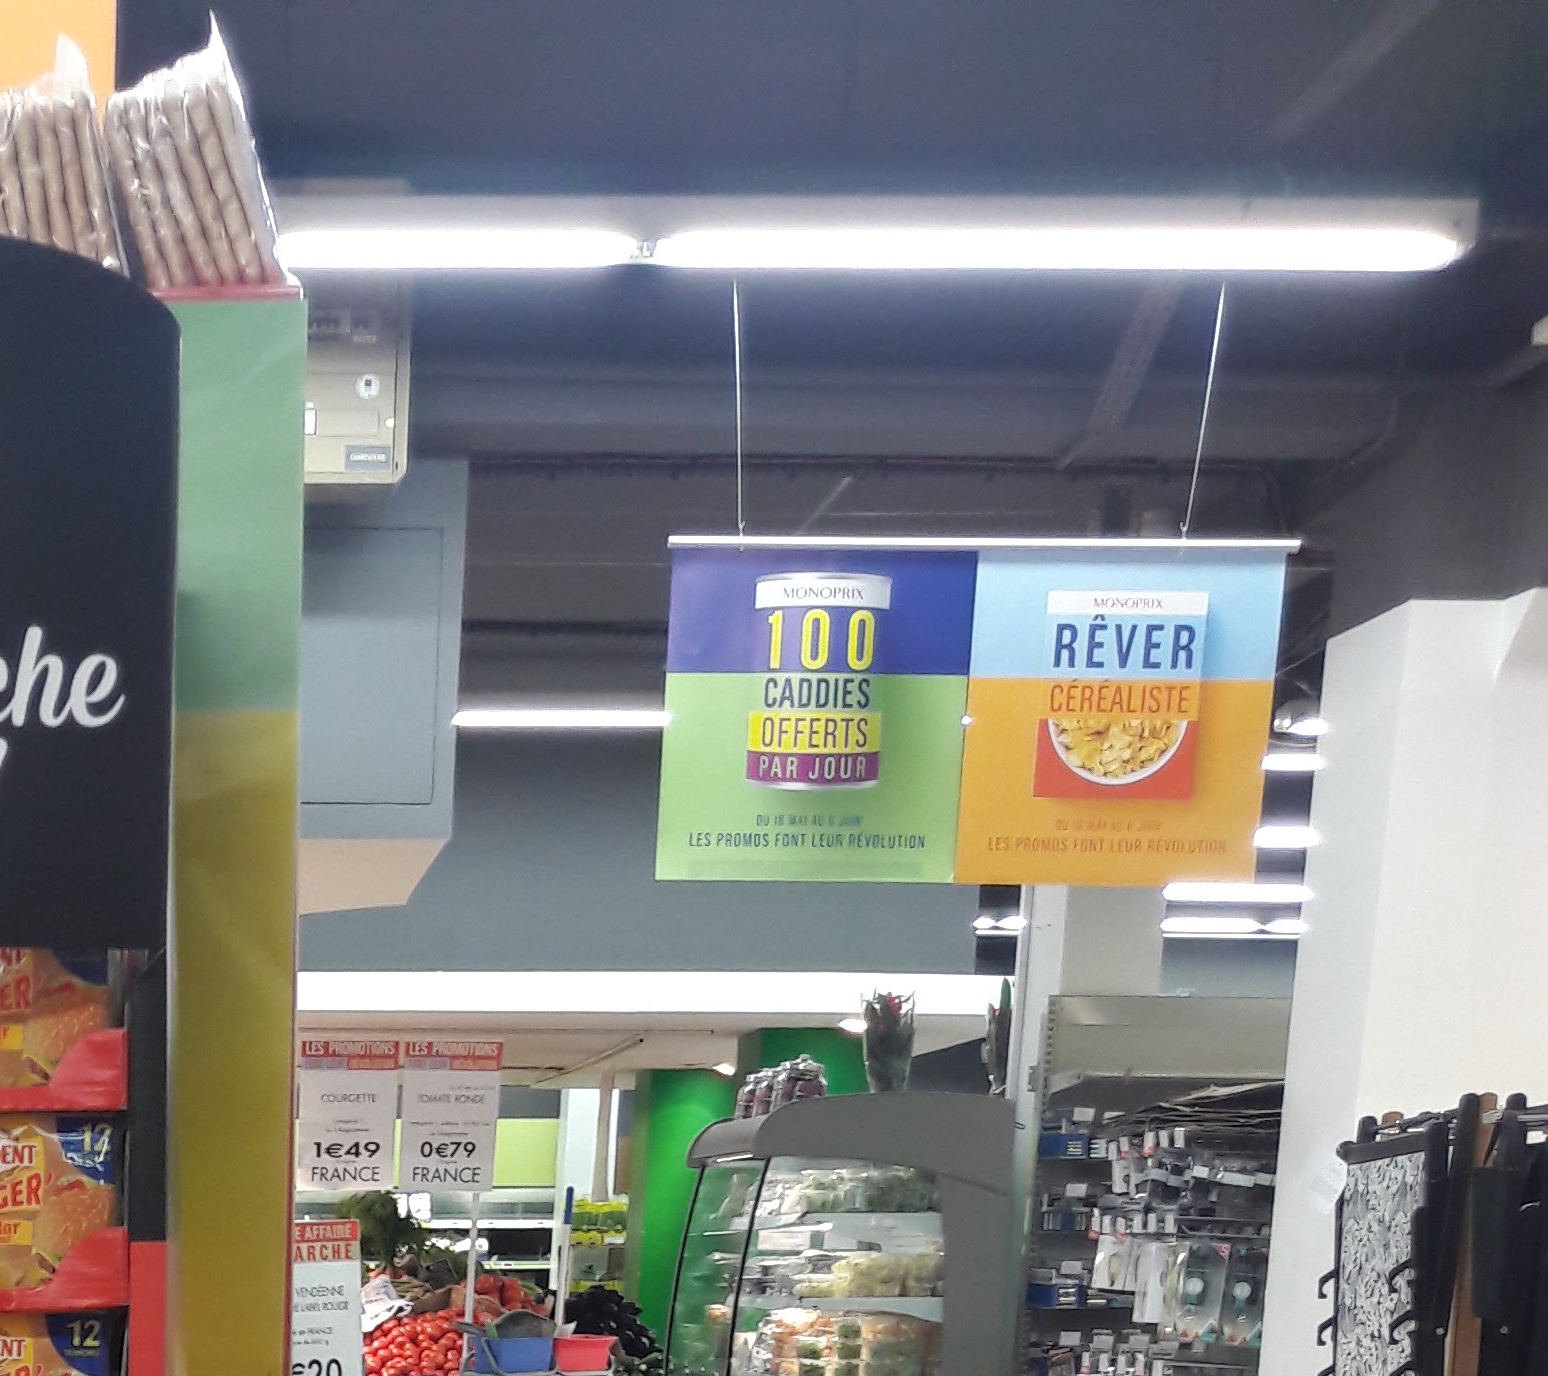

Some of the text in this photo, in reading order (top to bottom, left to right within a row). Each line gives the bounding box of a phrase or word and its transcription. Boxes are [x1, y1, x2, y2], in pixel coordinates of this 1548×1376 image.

[783, 586, 864, 600] MONOPRIX
[1093, 597, 1164, 609] MONOPRIX
[767, 608, 876, 672] 100
[1052, 614, 1196, 670] RÊVER
[764, 677, 871, 710] CADDIES
[1049, 679, 1191, 714] CÉRÉALISTE
[761, 717, 868, 749] OFFERTS
[758, 755, 866, 780] PAR JOUR
[689, 832, 711, 847] LES
[716, 833, 769, 848] PROMOS
[775, 833, 806, 848] FONT
[812, 833, 842, 848] LEUR
[305, 1041, 396, 1055] LES PROMOTIONS
[409, 1042, 498, 1056] LES PROMOTIONS
[313, 1141, 381, 1158] 1€49
[420, 1141, 476, 1158] 0€79
[311, 1166, 381, 1182] FRANCE
[412, 1166, 481, 1183] FRANCE
[294, 1243, 353, 1261] ARCHE
